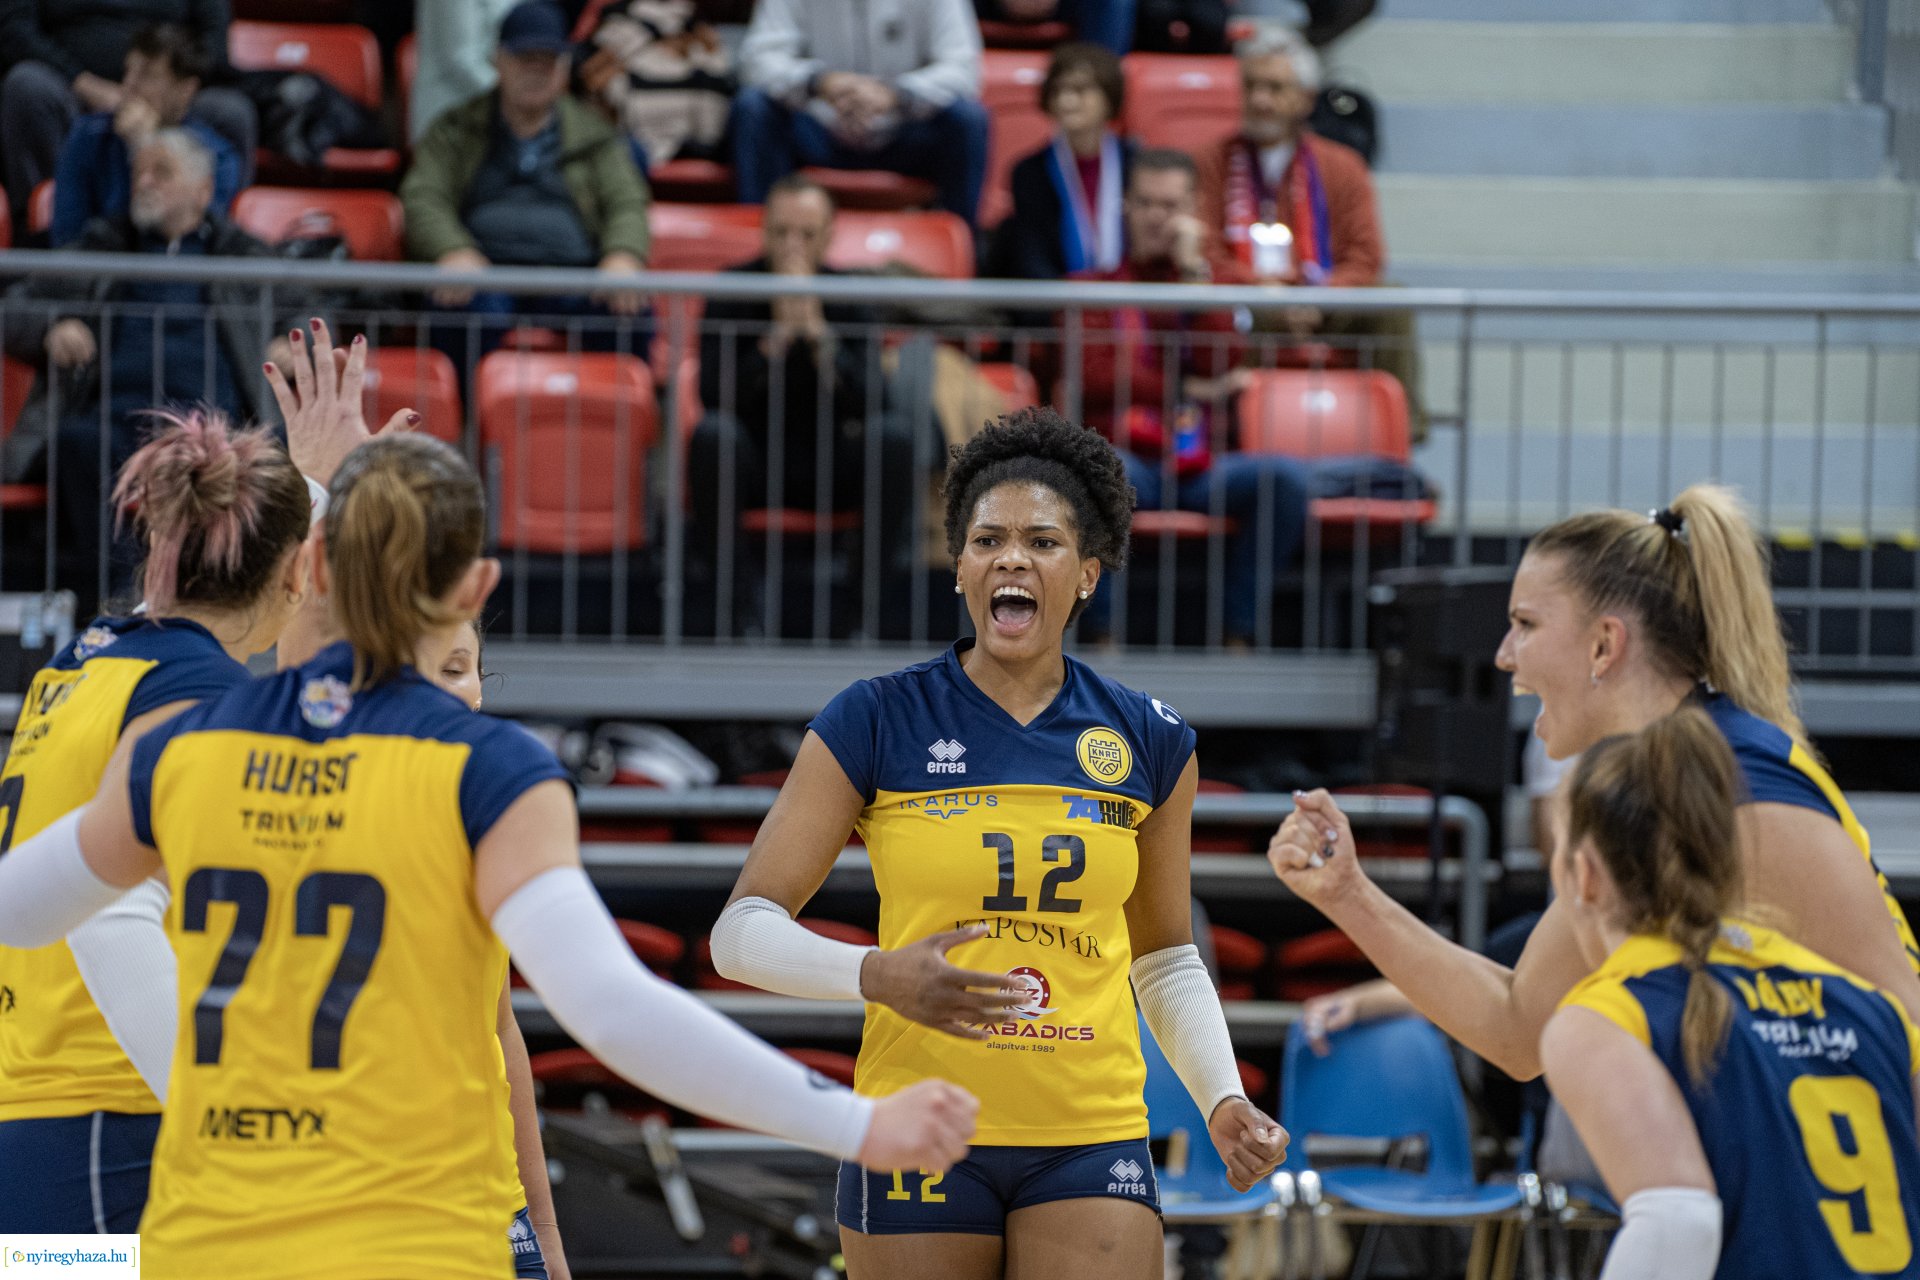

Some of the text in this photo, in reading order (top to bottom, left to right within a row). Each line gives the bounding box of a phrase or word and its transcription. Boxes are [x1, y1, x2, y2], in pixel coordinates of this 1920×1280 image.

[242, 750, 358, 796] HURST
[927, 761, 966, 774] errea
[899, 793, 998, 810] IKARUS
[982, 832, 1086, 913] 12
[182, 865, 387, 1071] 77
[970, 1022, 1095, 1042] ABADICS
[1032, 1044, 1055, 1053] 1989
[887, 1167, 946, 1203] 12
[1788, 1074, 1913, 1274] 9
[1107, 1182, 1147, 1195] errea
